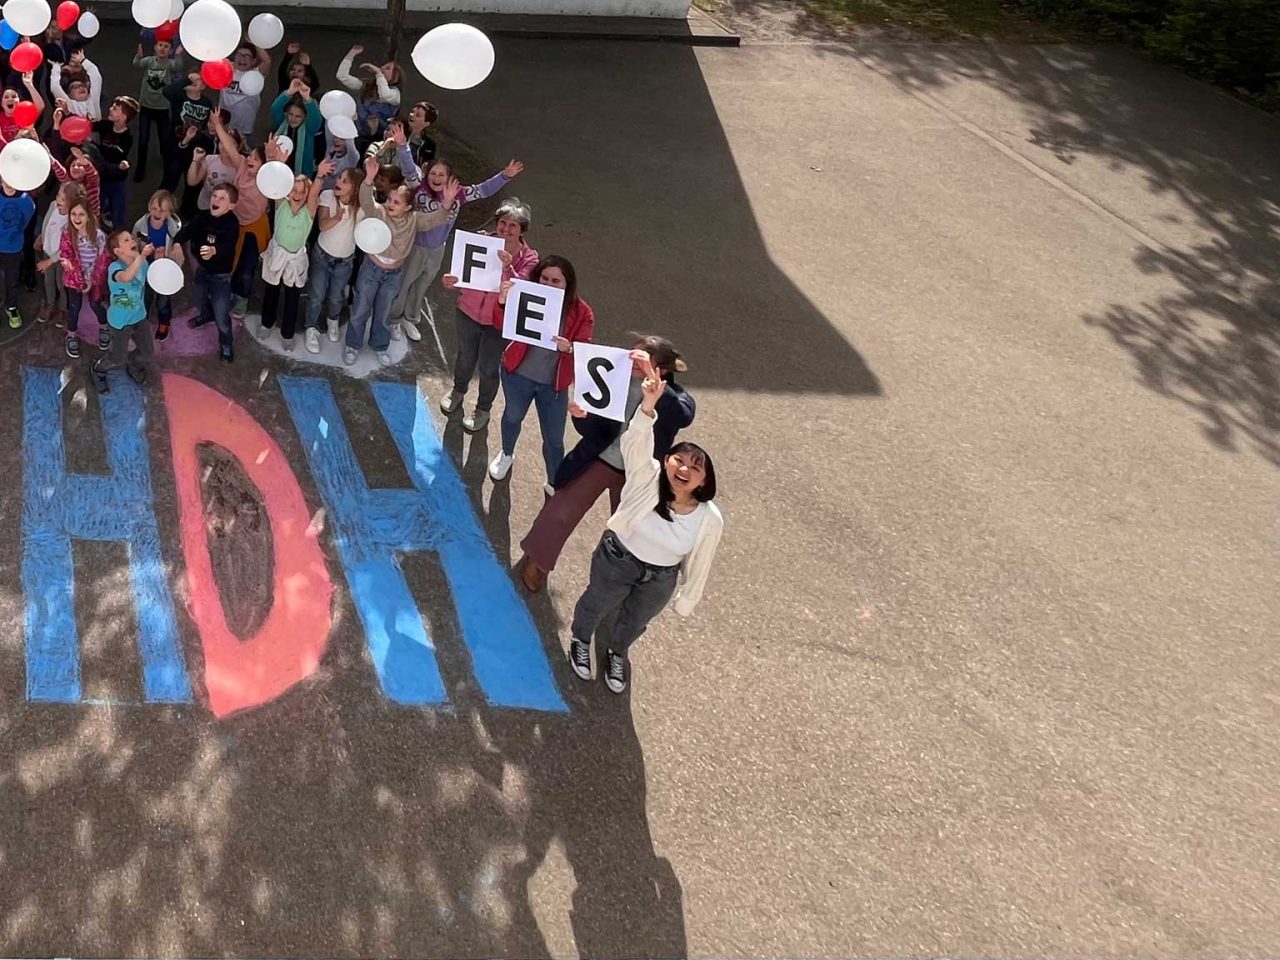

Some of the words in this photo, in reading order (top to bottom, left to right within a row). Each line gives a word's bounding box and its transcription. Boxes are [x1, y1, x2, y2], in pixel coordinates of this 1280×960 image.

[461, 243, 488, 283] F
[515, 292, 547, 340] E
[582, 356, 615, 409] S
[21, 364, 570, 718] HDH
